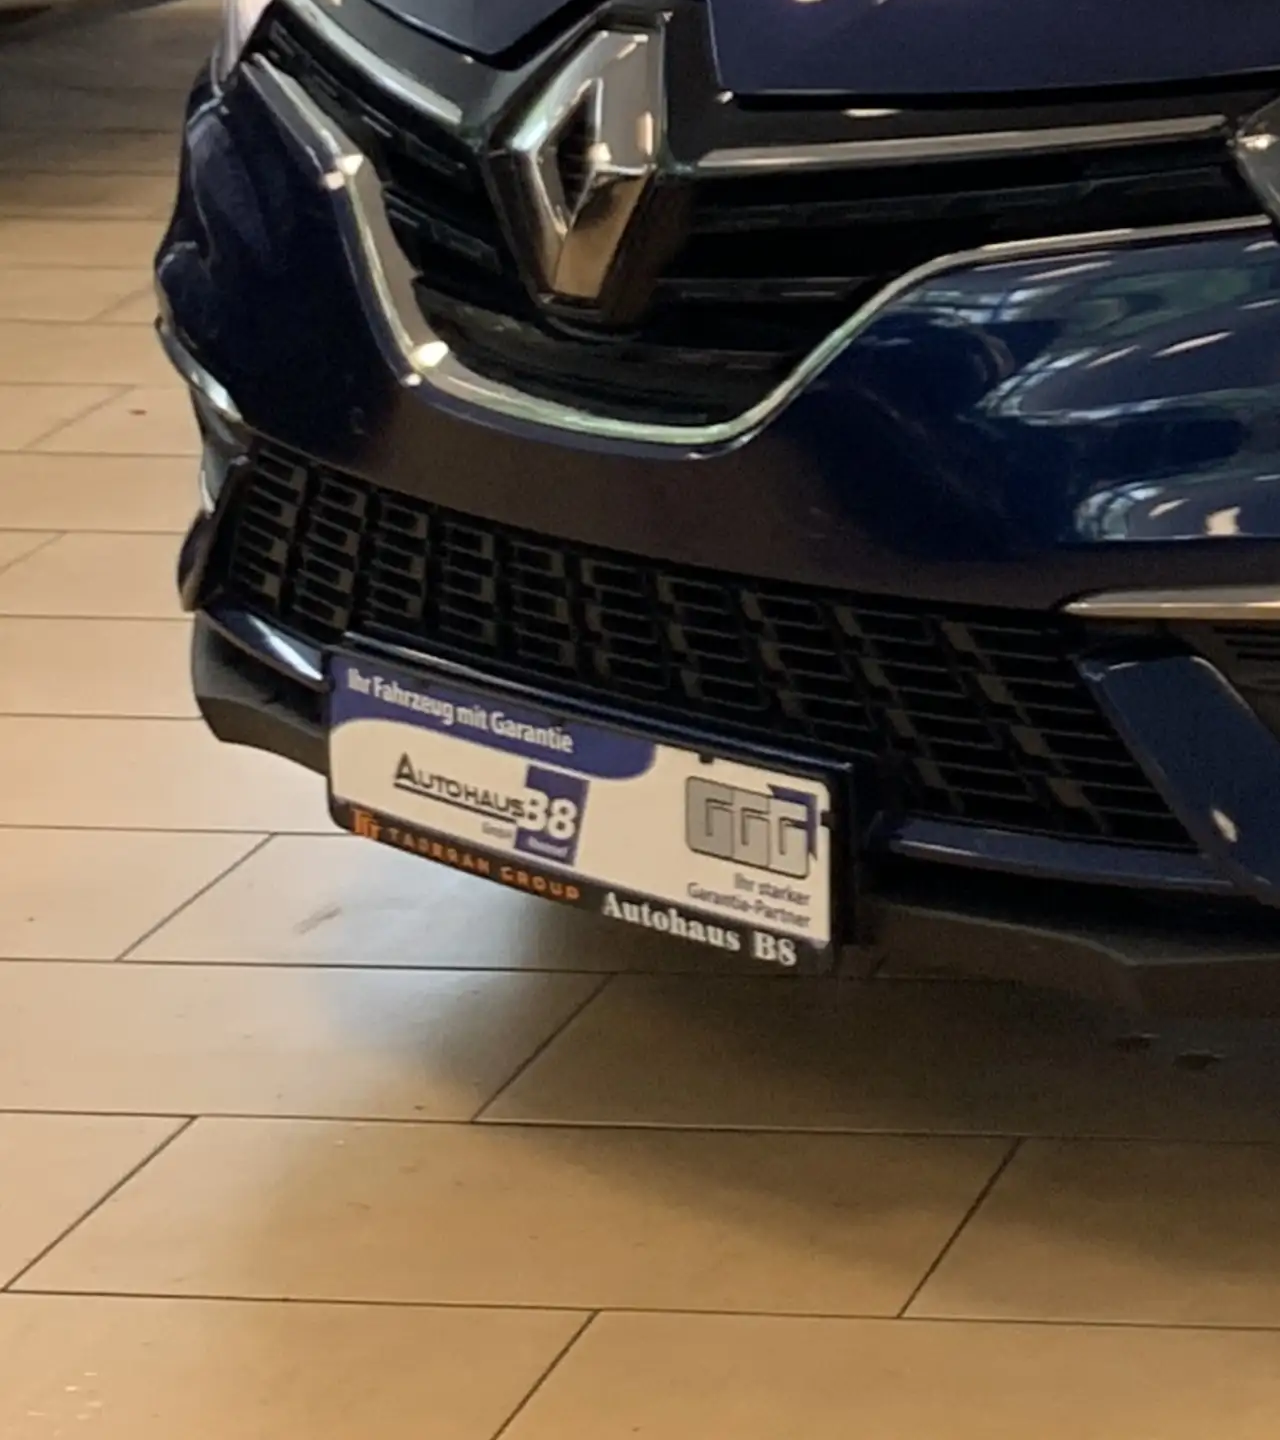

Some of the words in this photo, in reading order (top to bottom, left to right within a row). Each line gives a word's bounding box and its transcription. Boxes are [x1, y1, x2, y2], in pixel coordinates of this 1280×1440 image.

[347, 667, 372, 694] Ihr
[373, 676, 454, 726] Fahrzeug
[456, 703, 489, 732] mit
[490, 711, 574, 754] Garantie
[602, 891, 742, 952] Autohaus
